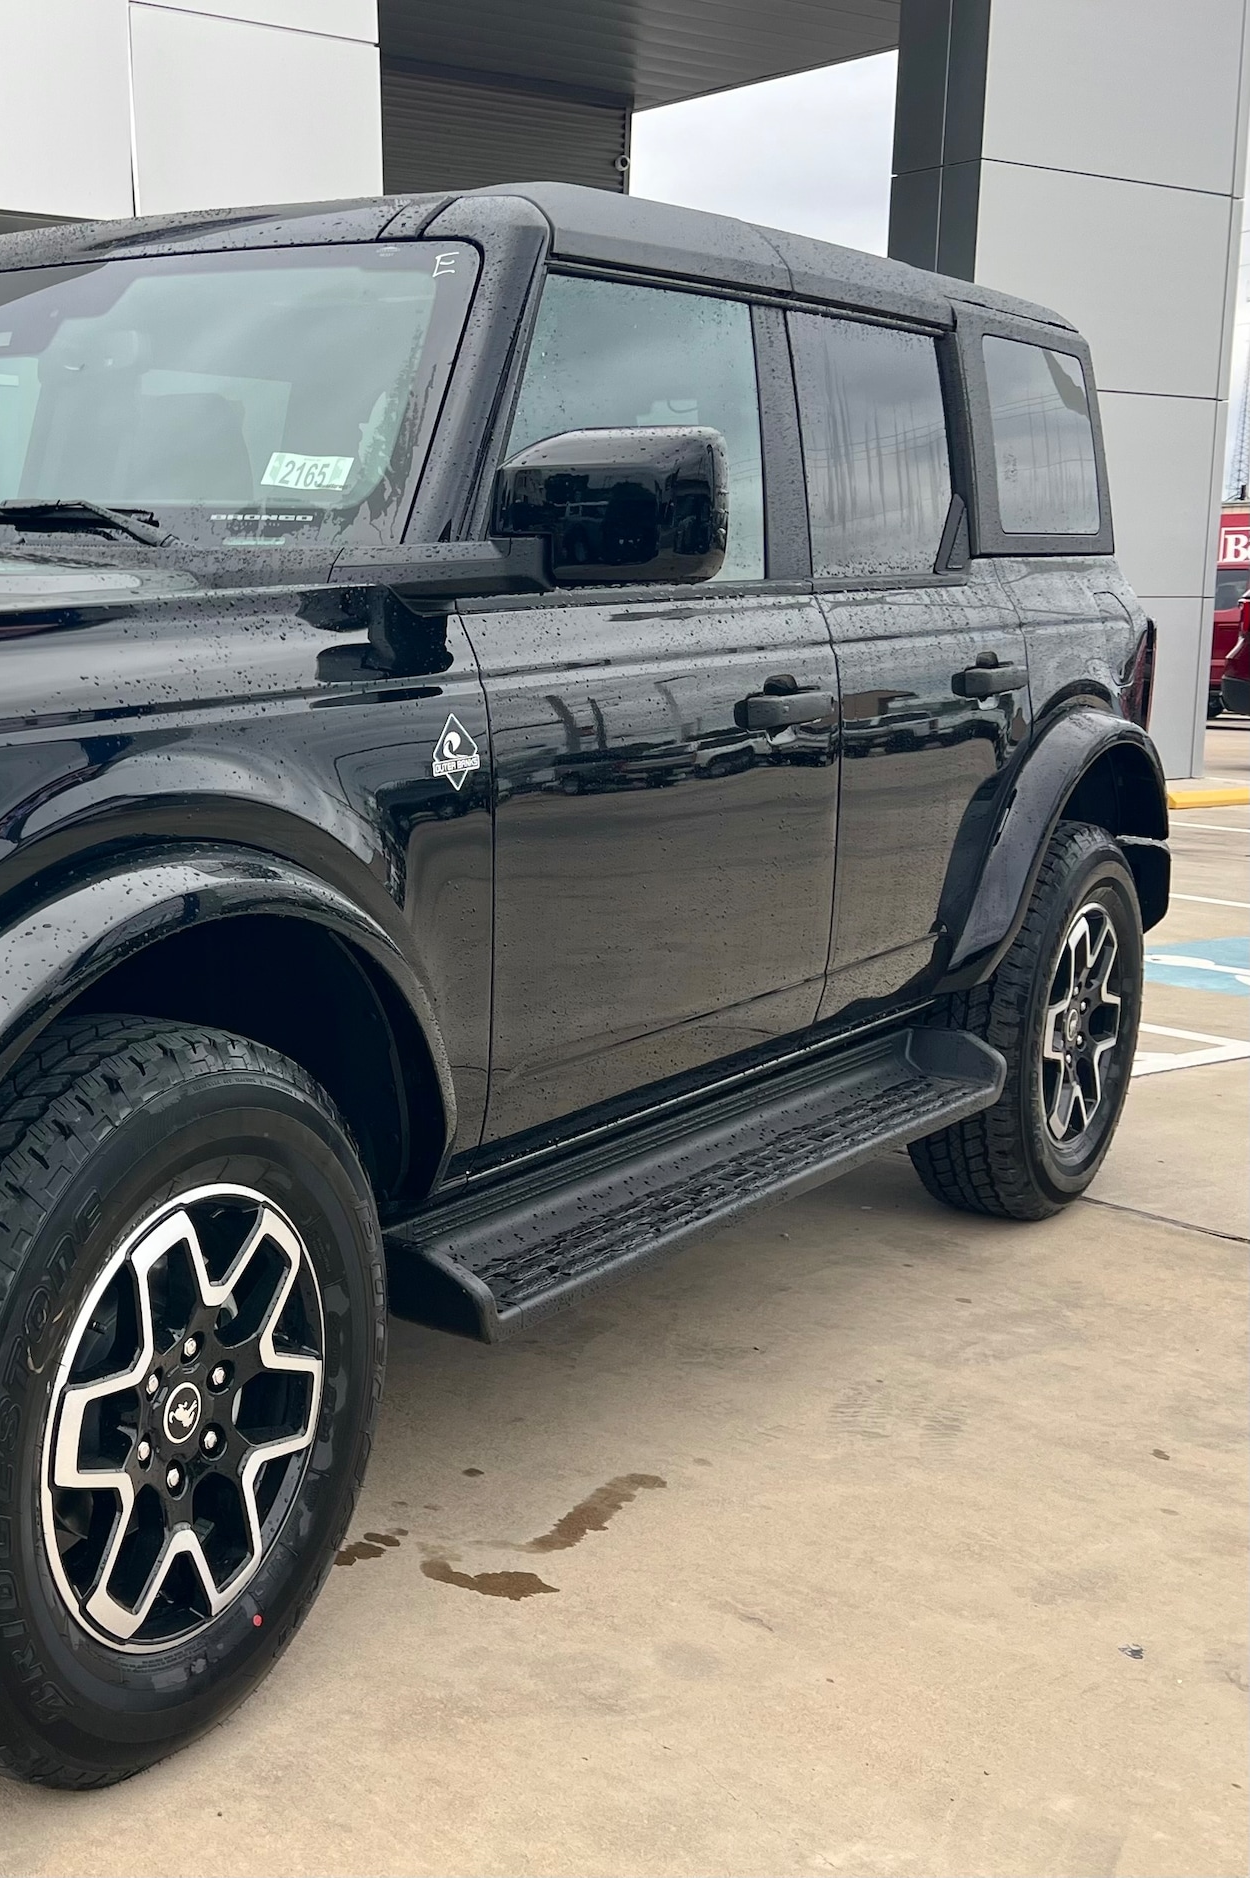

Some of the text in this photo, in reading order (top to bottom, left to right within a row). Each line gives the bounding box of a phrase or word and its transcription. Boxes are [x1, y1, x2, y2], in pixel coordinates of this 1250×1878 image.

[431, 251, 460, 278] E
[279, 460, 330, 487] 2165
[435, 757, 478, 773] OUTER BANKS
